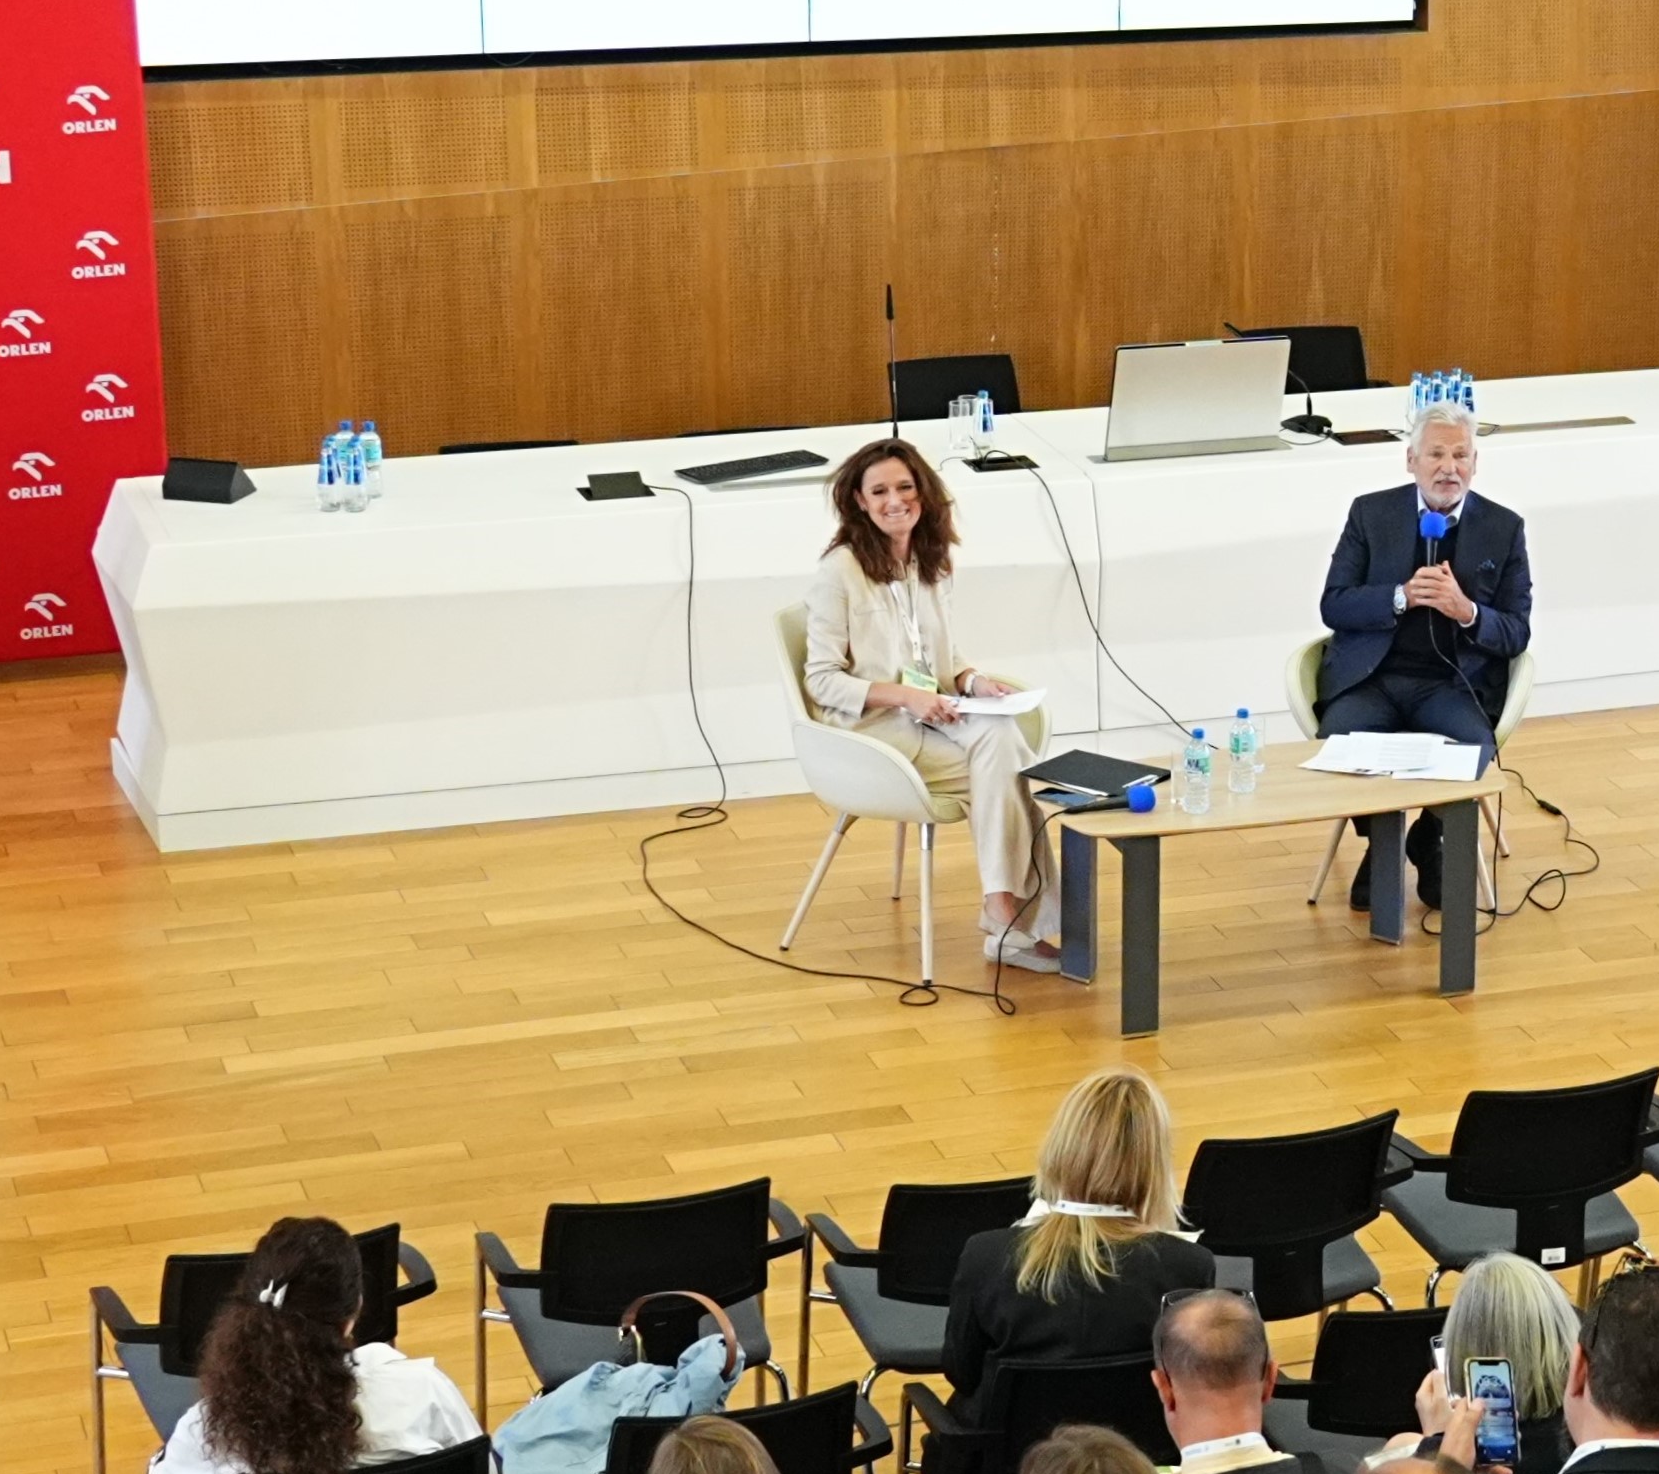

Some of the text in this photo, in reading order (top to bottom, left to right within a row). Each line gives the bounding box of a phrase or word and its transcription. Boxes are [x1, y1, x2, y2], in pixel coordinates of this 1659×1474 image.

[62, 118, 117, 134] ORLEN
[71, 262, 126, 279] ORLEN
[81, 405, 135, 422] ORLEN
[8, 483, 63, 500] ORLEN
[19, 623, 74, 640] ORLEN
